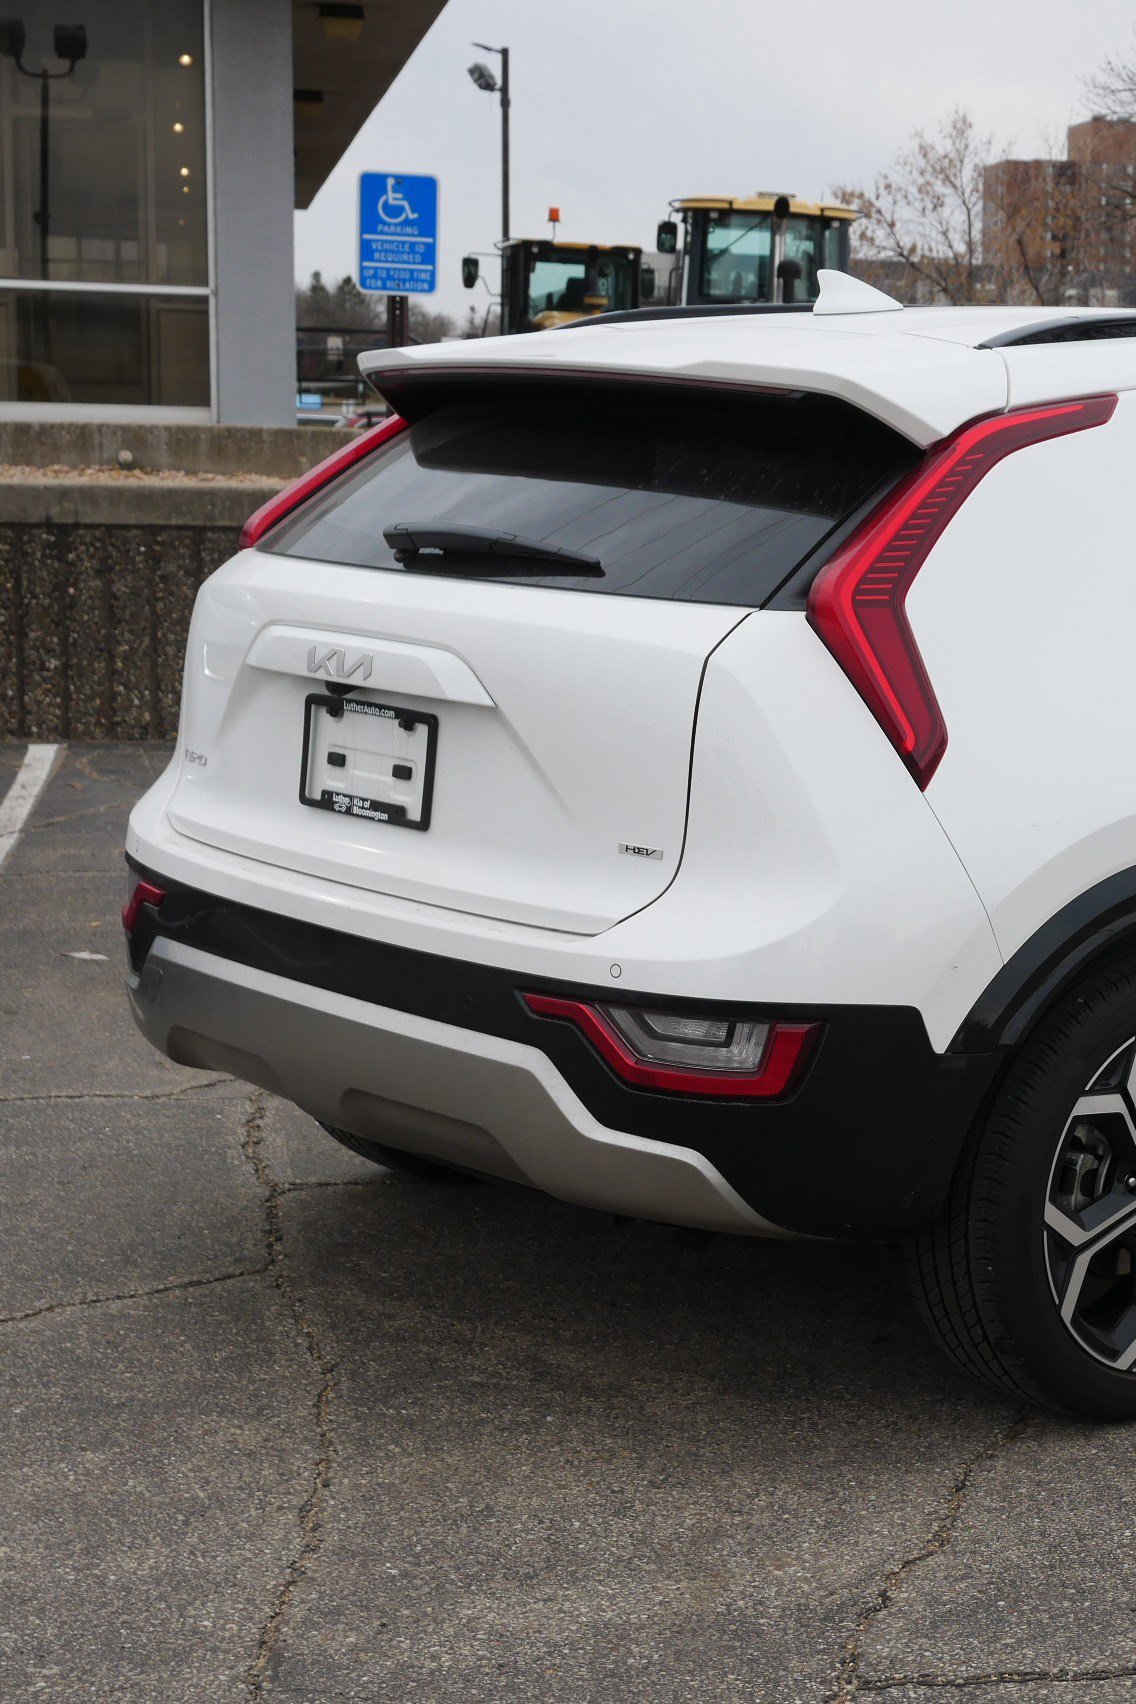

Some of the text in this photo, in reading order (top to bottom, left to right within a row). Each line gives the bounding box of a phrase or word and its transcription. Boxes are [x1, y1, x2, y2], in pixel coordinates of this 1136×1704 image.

[377, 224, 419, 235] PARKING
[371, 241, 410, 252] VEHICLE
[374, 252, 422, 262] REQUIRED
[363, 268, 374, 277] UP
[377, 268, 387, 278] TO
[413, 271, 431, 280] FINE
[366, 279, 429, 290] FOR VIOLATION
[343, 701, 395, 718] LutherAuto.com
[353, 797, 371, 809] Kia of
[352, 806, 388, 821] Bloomington
[625, 845, 656, 856] HEV
